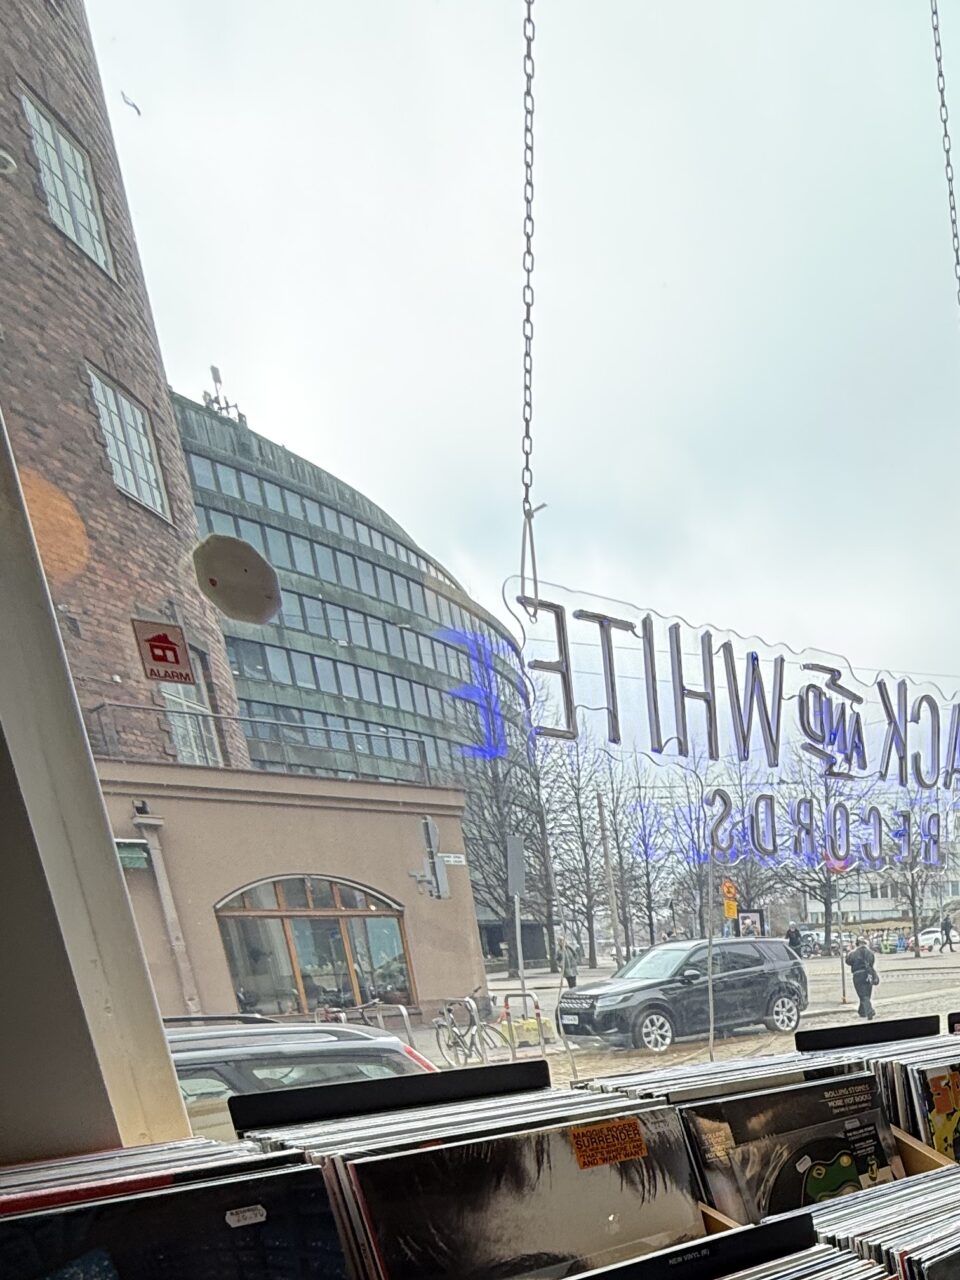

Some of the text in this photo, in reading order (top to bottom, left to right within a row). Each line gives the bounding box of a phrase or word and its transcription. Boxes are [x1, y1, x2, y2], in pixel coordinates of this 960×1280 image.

[149, 668, 192, 682] ALARM
[573, 1121, 638, 1140] MAGGIE ROGERS
[575, 1129, 641, 1149] SURRENDER
[582, 1159, 599, 1168] AND
[668, 1255, 683, 1265] NEW
